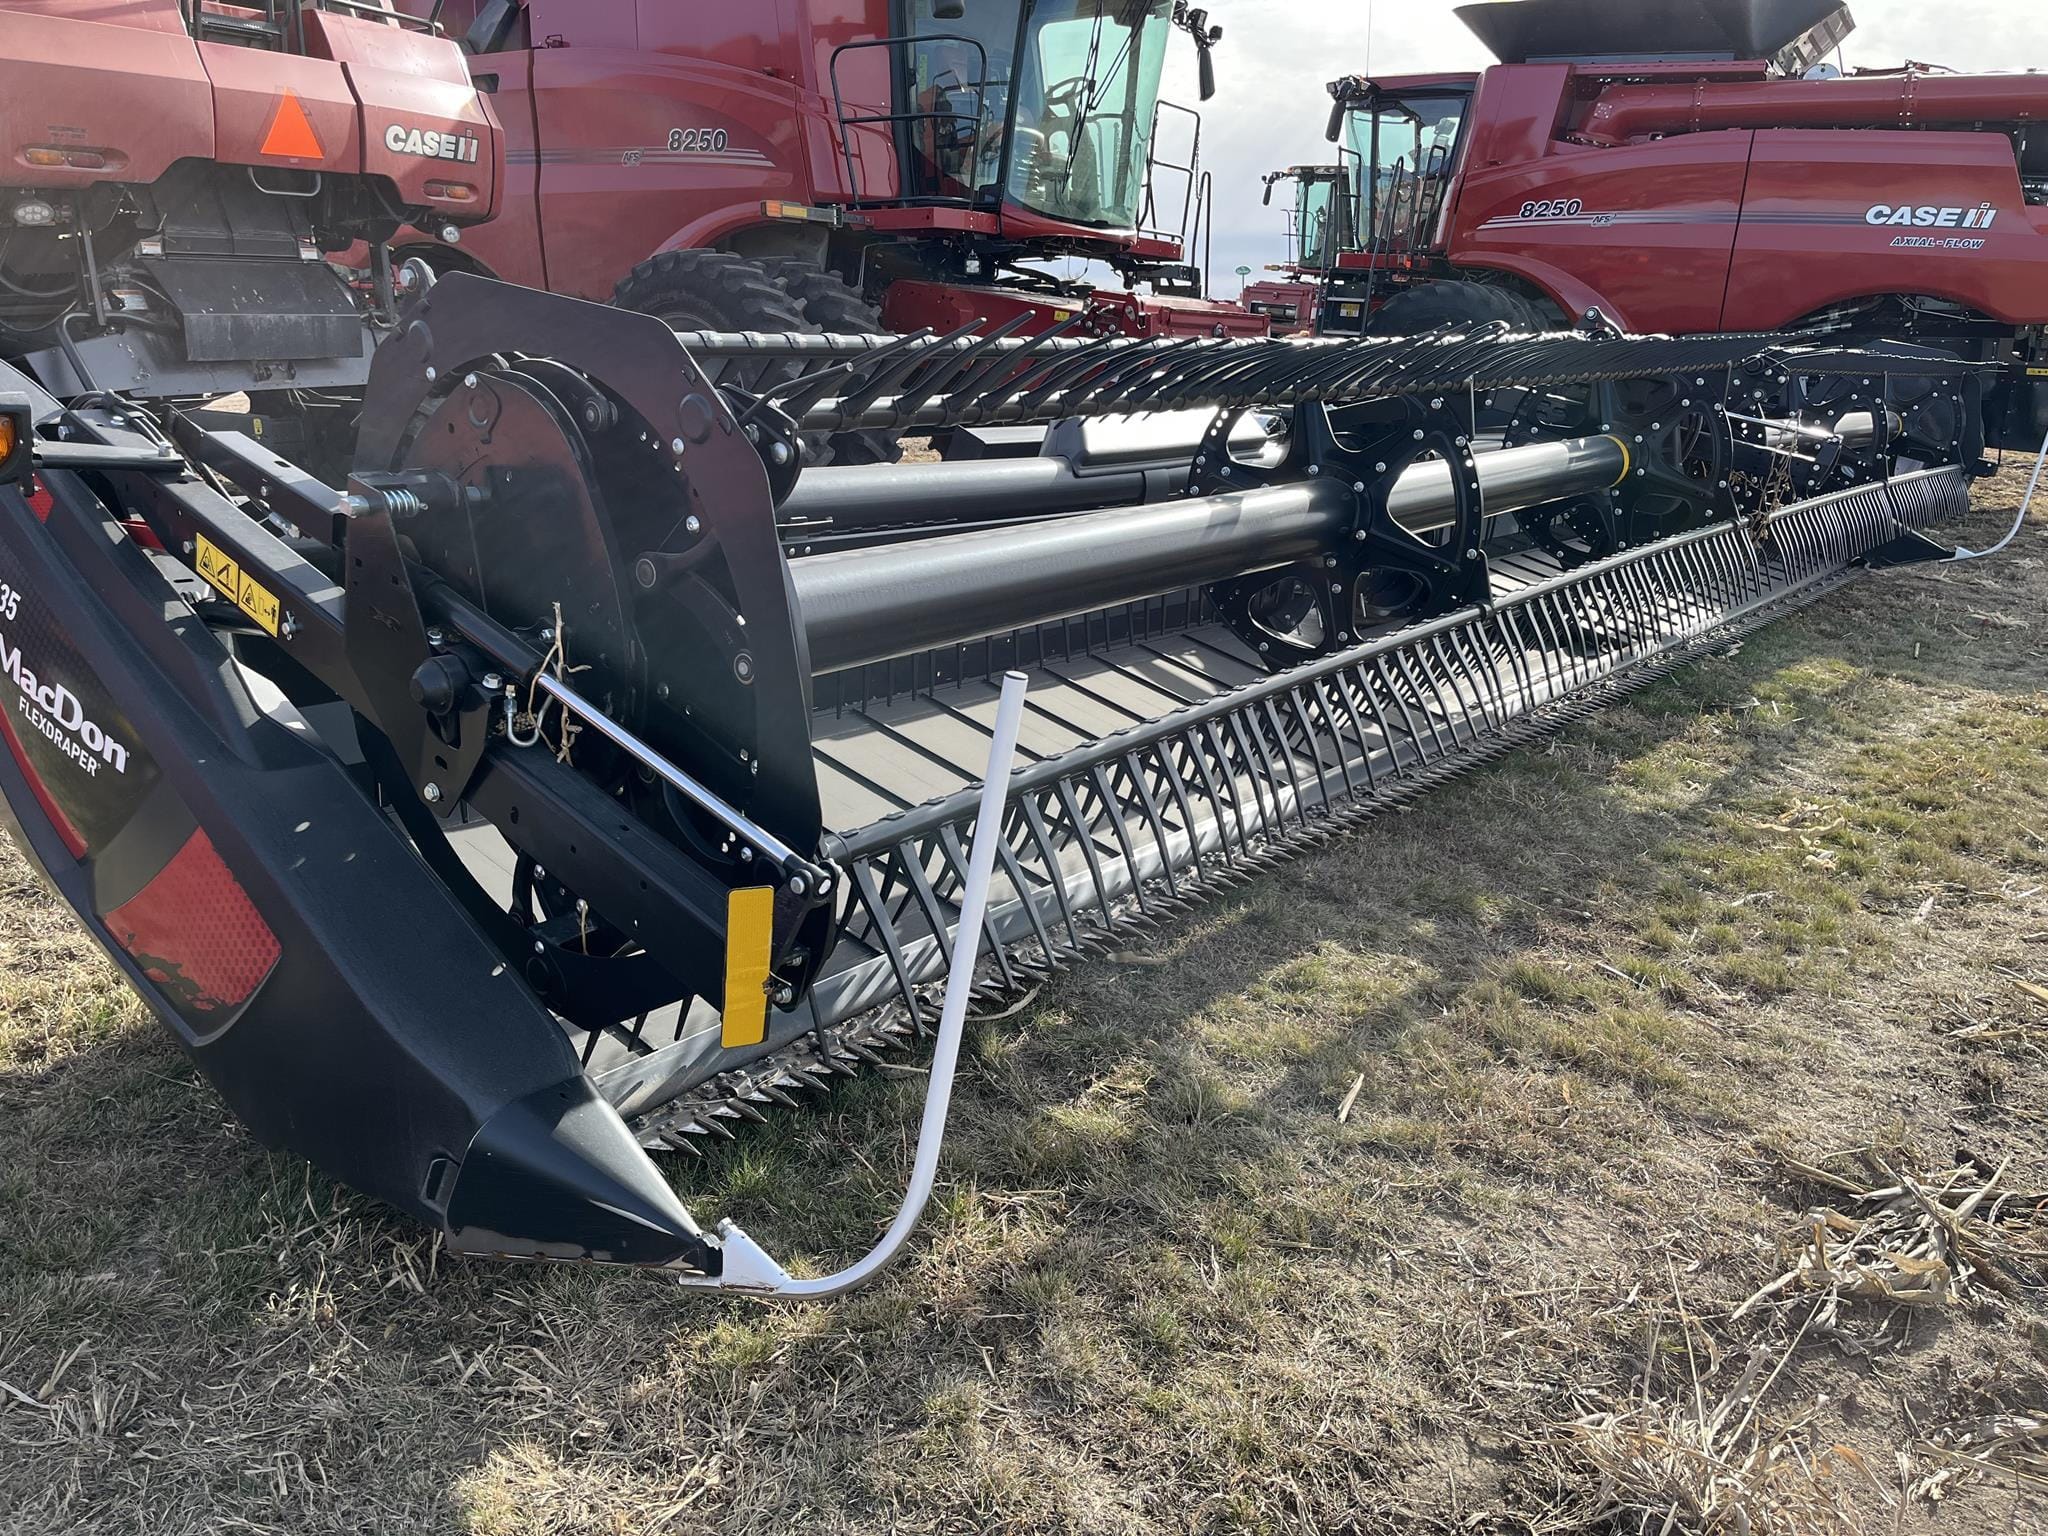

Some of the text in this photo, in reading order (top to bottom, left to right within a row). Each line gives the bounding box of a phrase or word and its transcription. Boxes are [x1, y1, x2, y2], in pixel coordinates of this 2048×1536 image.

[384, 124, 456, 160] CASE
[667, 127, 728, 153] 8250
[1519, 198, 1583, 219] 8250
[1865, 204, 1962, 227] CASE
